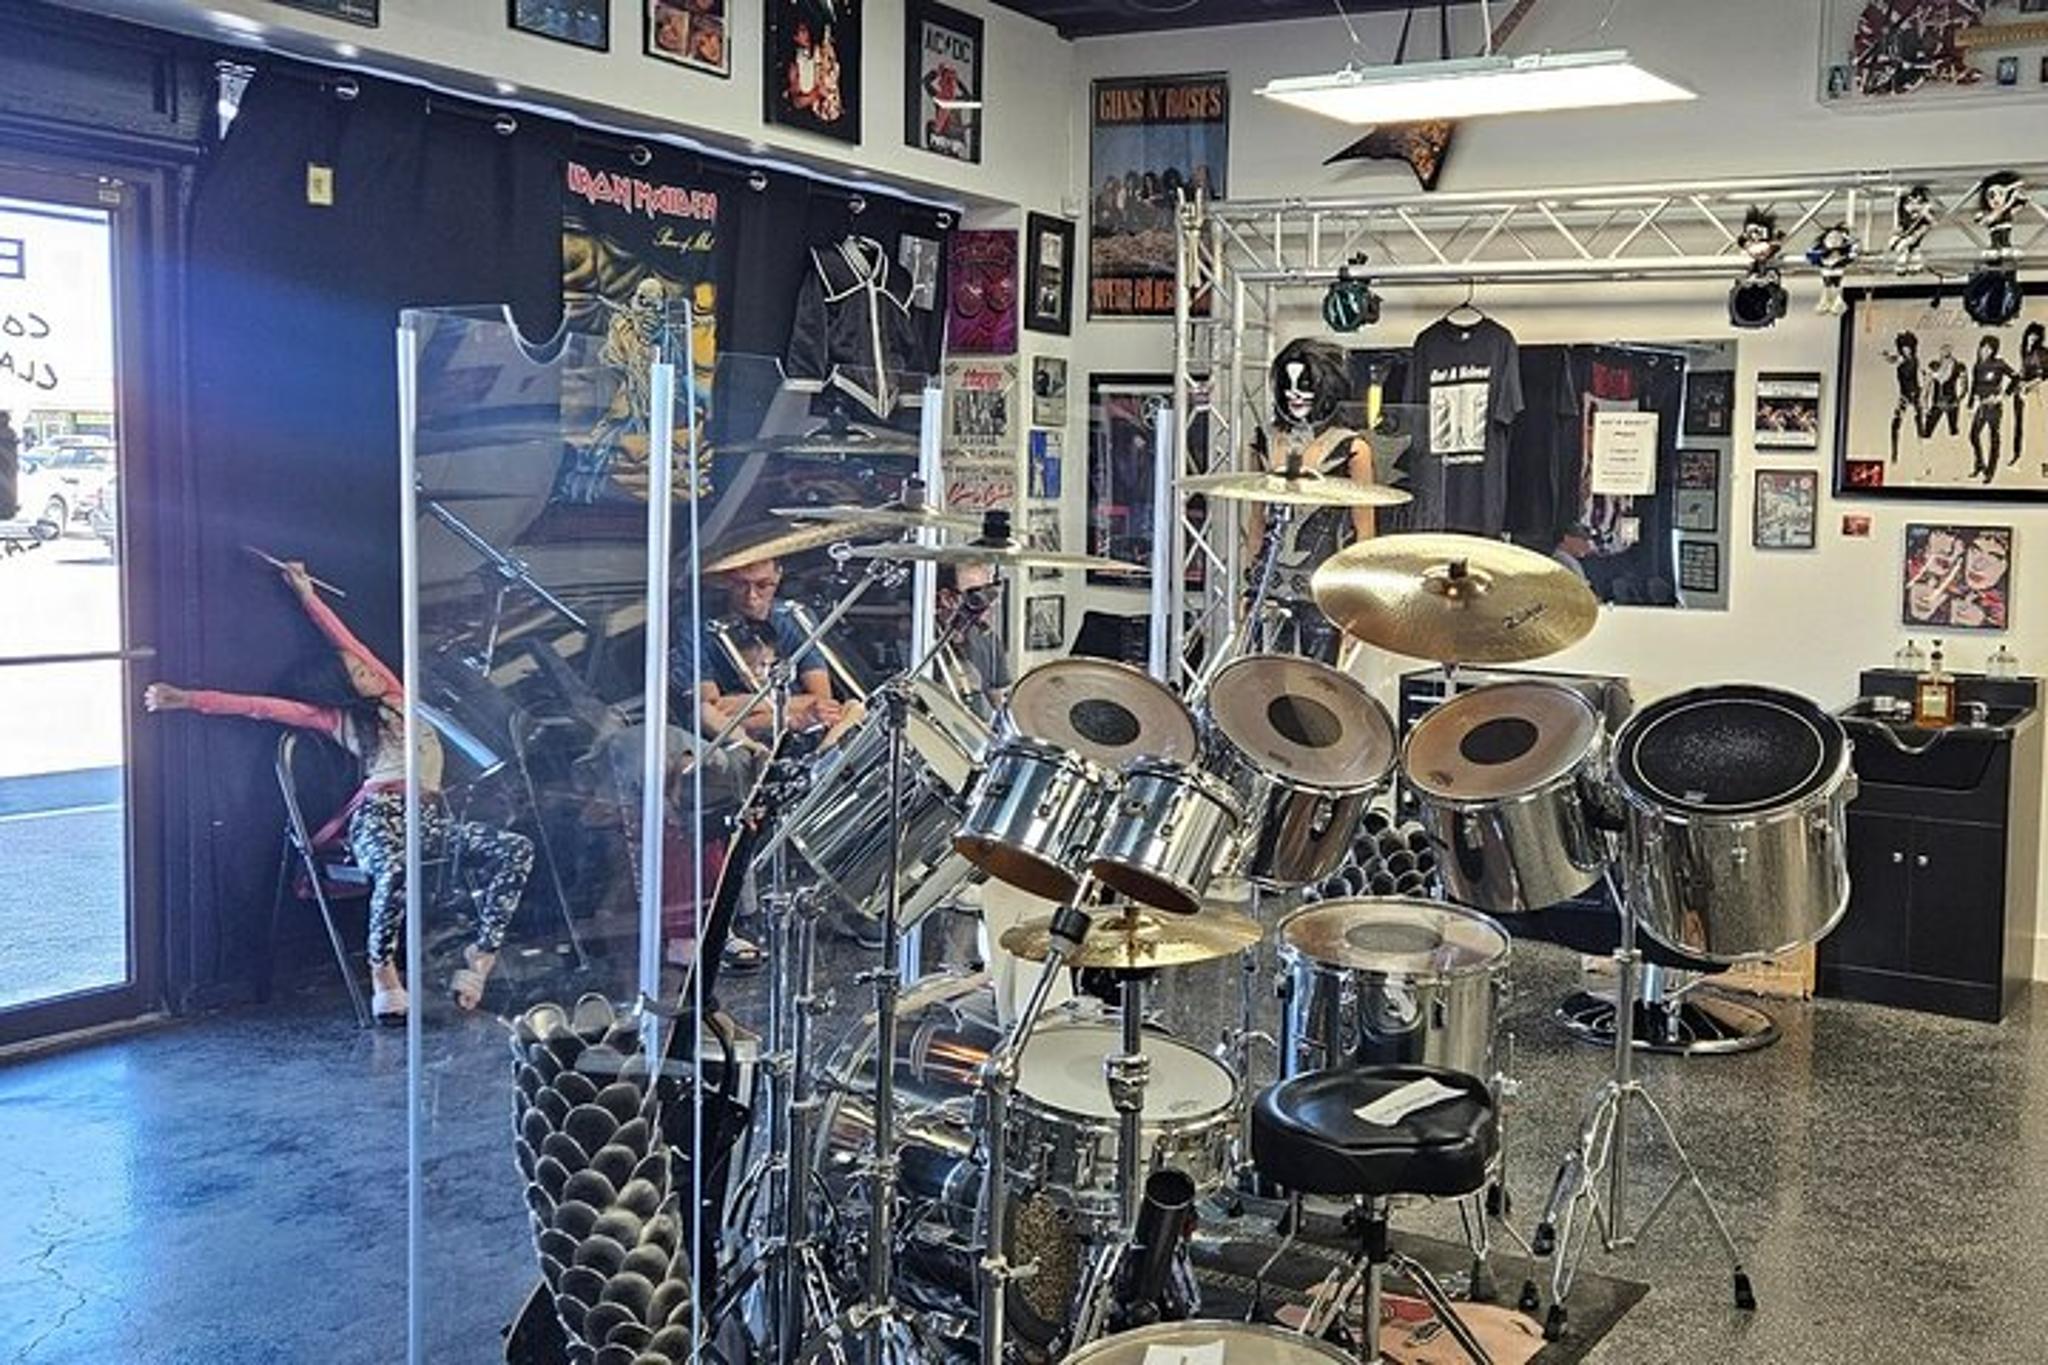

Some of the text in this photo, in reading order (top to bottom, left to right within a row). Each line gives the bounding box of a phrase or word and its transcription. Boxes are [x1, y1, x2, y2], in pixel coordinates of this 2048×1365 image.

[1100, 90, 1144, 120] GUNS
[1166, 86, 1221, 118] ROSES
[568, 161, 718, 224] IRON MAIDEN
